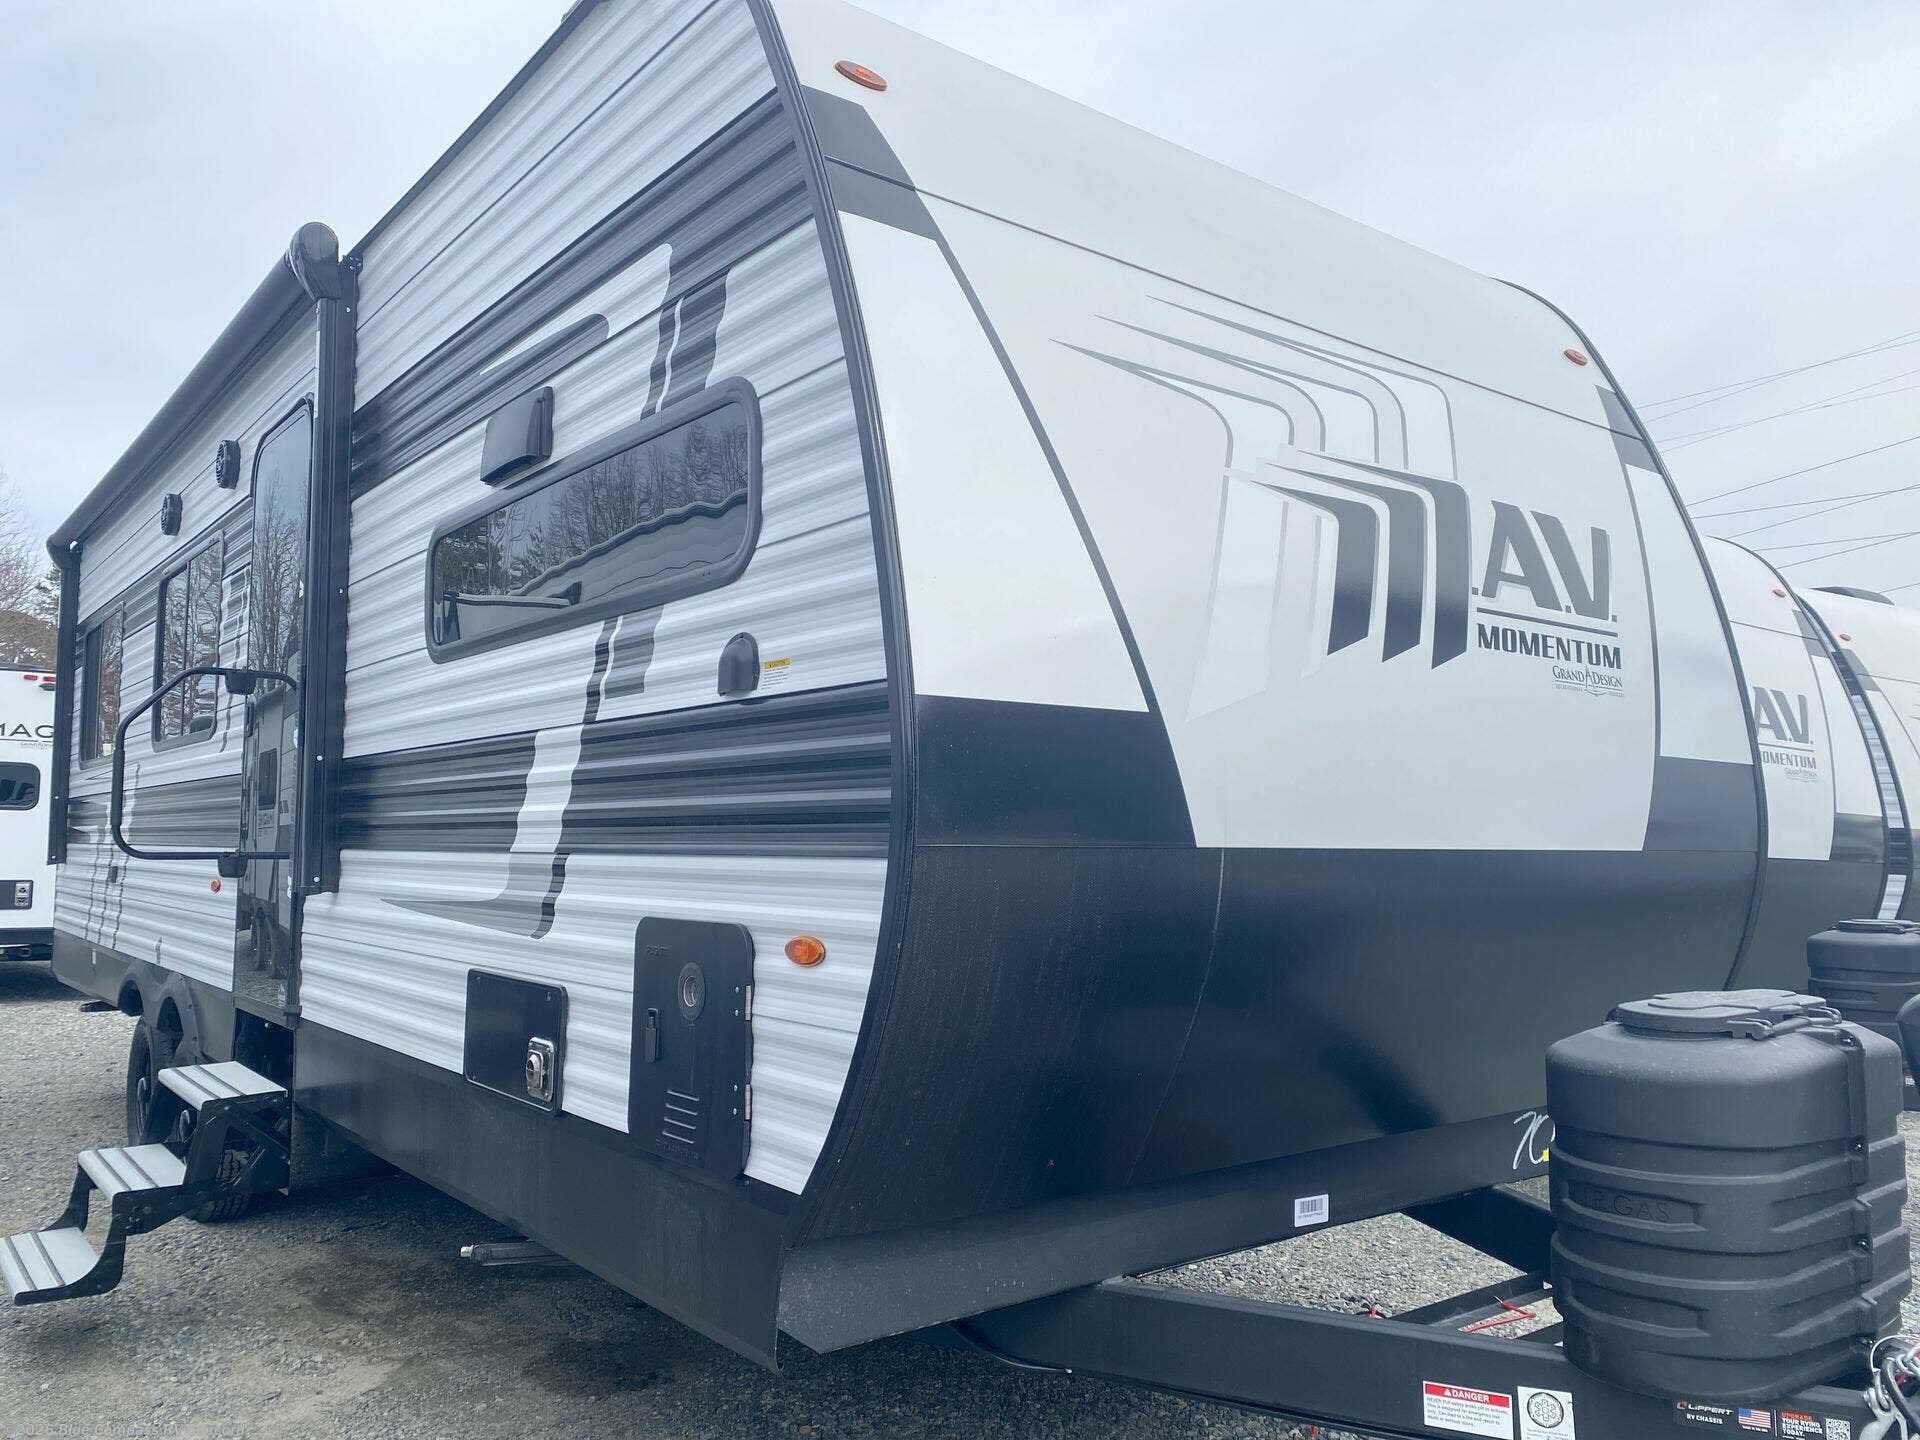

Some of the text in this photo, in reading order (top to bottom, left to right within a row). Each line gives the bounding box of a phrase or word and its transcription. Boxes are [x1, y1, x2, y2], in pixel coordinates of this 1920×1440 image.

[1476, 622, 1622, 669] MOMENTUM
[1552, 665, 1623, 688] GRAND DESIGN
[1762, 750, 1816, 769] OMENTUM
[1613, 1194, 1671, 1223] GAS
[1451, 1389, 1490, 1403] DANGER
[1695, 1415, 1723, 1425] CHASSIS
[1782, 1423, 1823, 1434] EXPERIENCE
[1782, 1428, 1805, 1437] TODAY.
